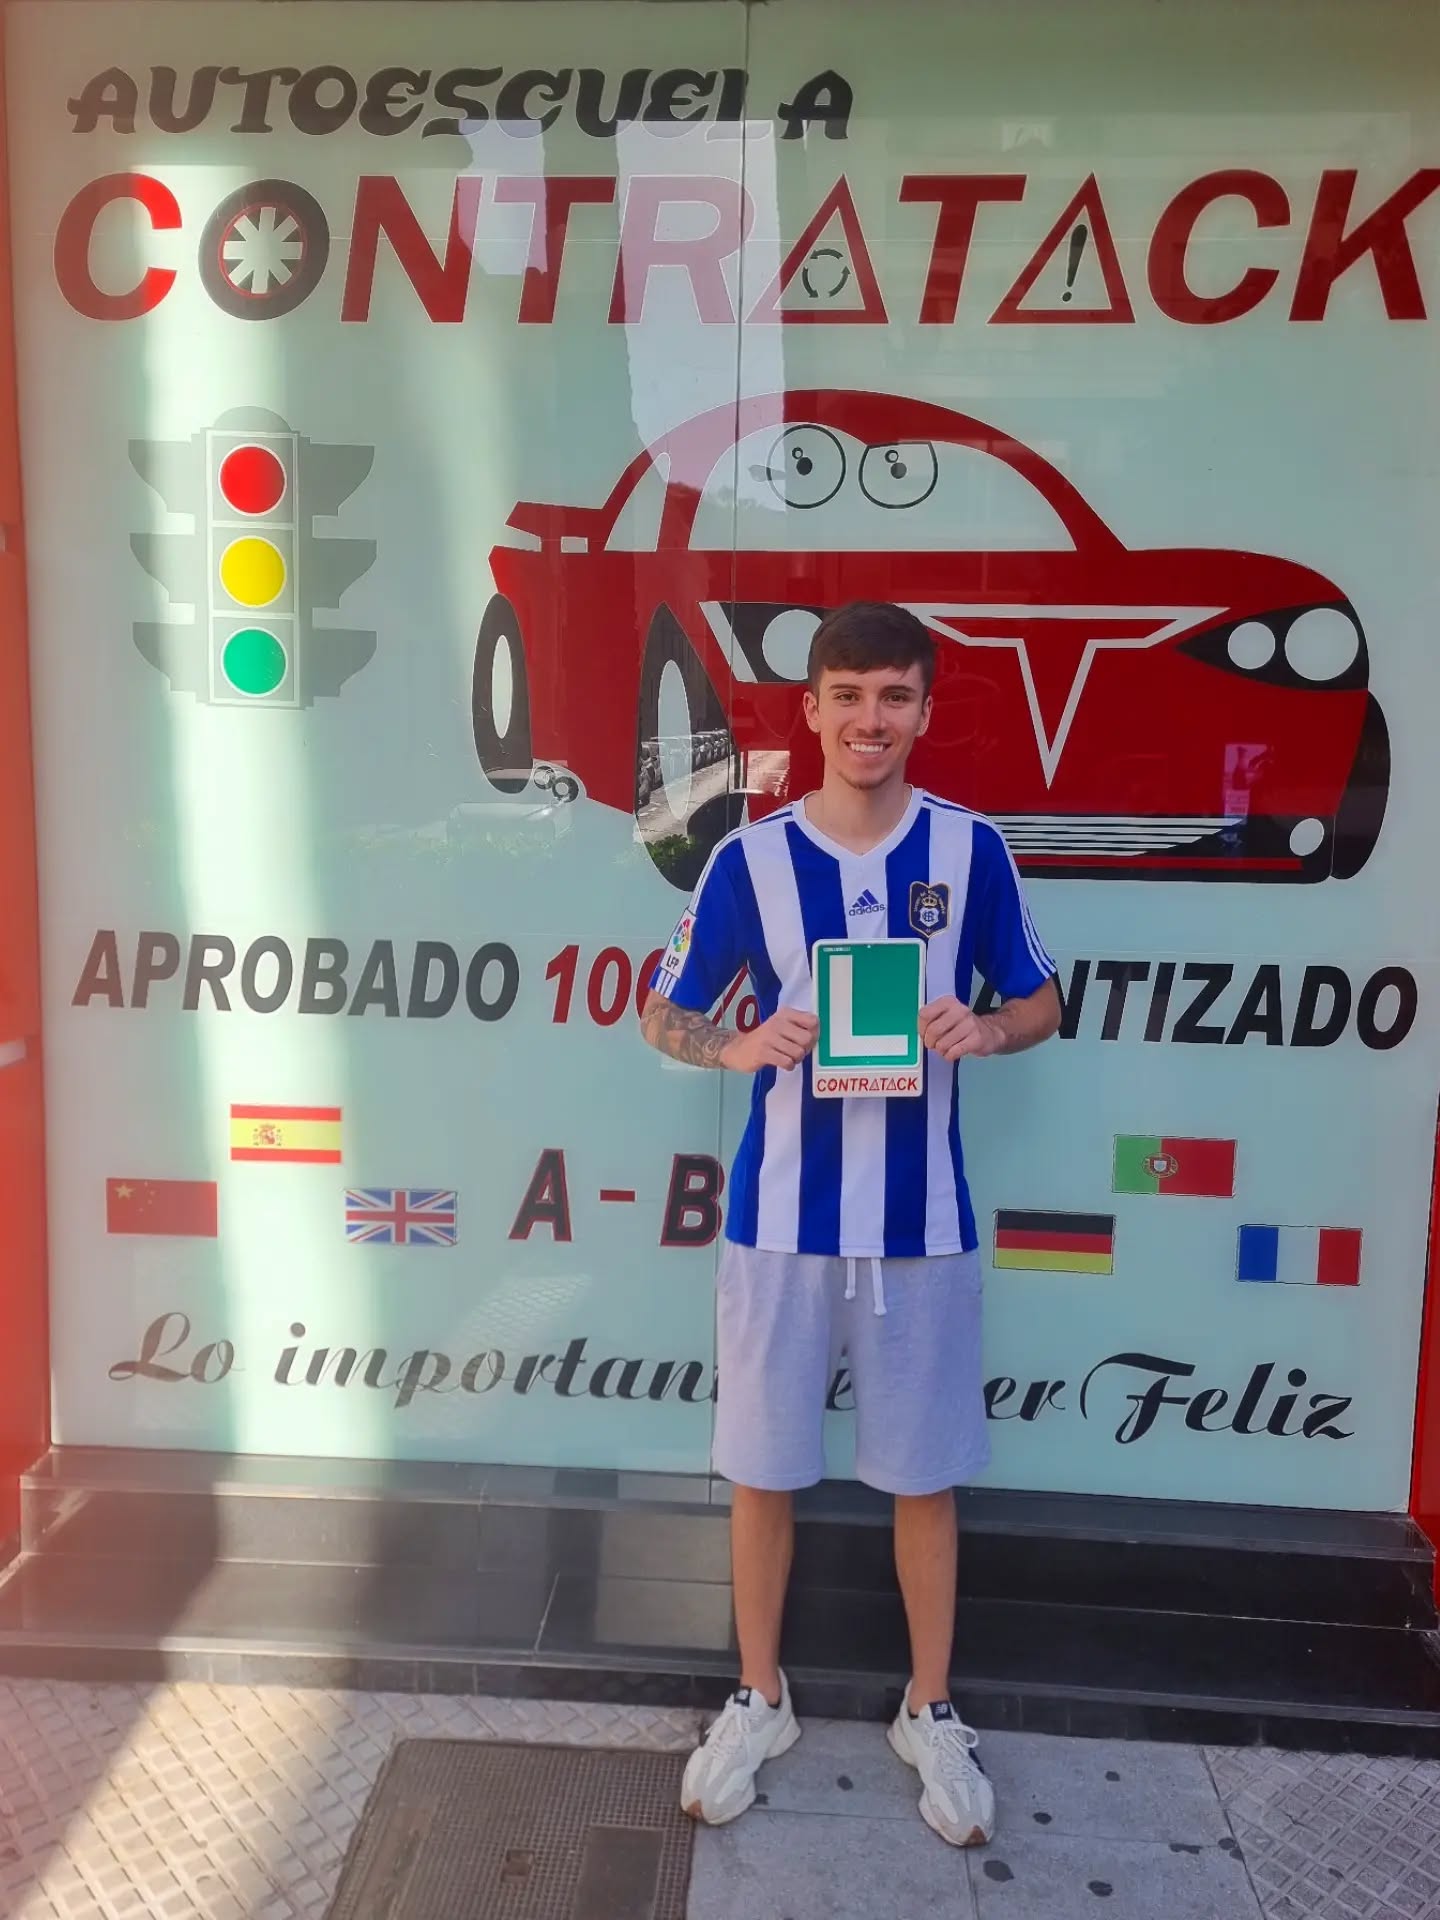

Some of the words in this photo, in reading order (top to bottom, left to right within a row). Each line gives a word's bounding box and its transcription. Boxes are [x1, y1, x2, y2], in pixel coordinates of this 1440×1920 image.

[66, 65, 853, 142] AUTOESCUELA
[52, 168, 1440, 326] CONTRATACK
[848, 902, 886, 917] adidas
[71, 929, 520, 1022] APROBADO
[973, 959, 1418, 1050] NTIZADO
[666, 954, 680, 970] LFP
[829, 955, 908, 1058] L
[816, 1076, 919, 1093] CONTRATACK
[508, 1148, 572, 1242] A
[660, 1153, 725, 1247] B
[108, 1311, 240, 1385] Lo
[273, 1321, 718, 1409] importan
[983, 1375, 1067, 1422] er
[1079, 1352, 1355, 1444] Feliz
